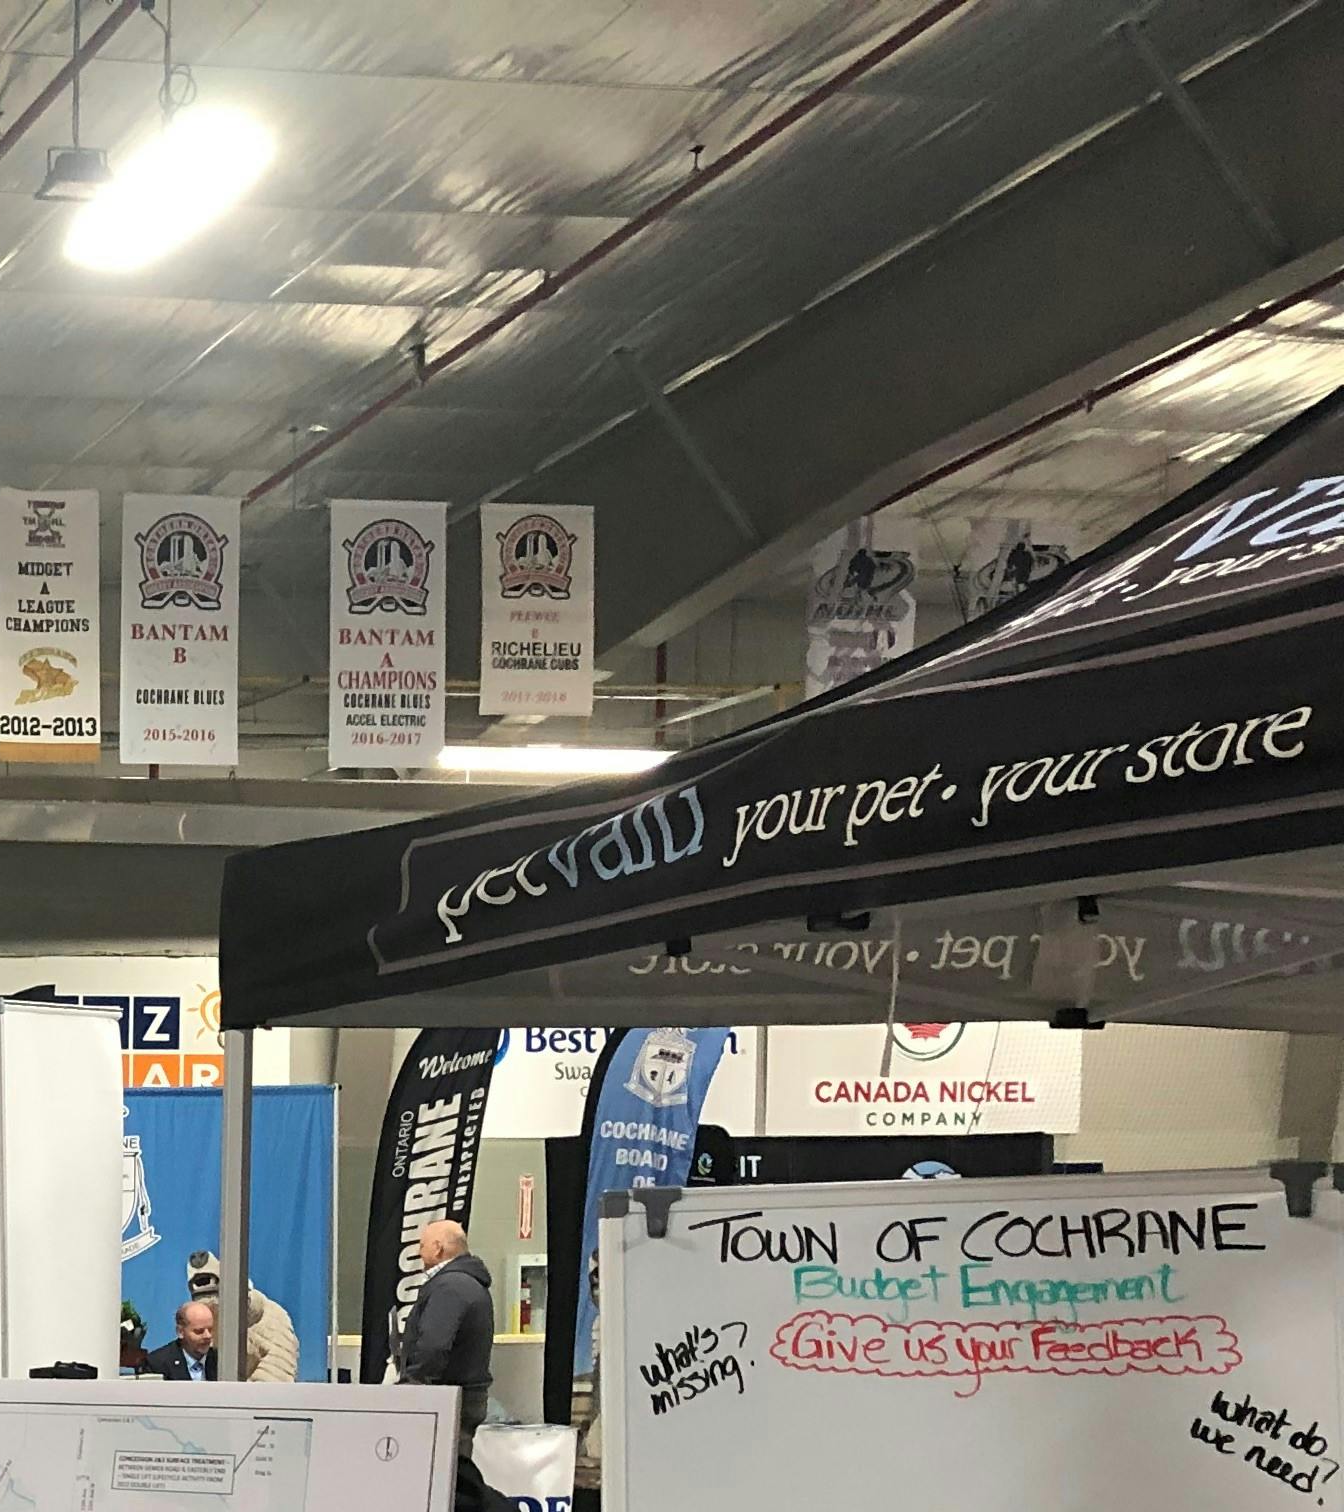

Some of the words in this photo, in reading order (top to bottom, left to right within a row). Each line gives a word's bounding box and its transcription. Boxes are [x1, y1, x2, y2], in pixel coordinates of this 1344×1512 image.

[18, 600, 75, 614] LEAGUE
[5, 617, 90, 633] CHAMPIONS
[131, 623, 229, 641] BANTAM
[338, 628, 435, 647] BANTAM
[491, 641, 582, 657] RICHELIEU
[337, 670, 437, 691] CHAMPIONS
[136, 689, 189, 706] COCHRANE
[194, 689, 225, 706] BLUES
[0, 715, 97, 737] 2012-2013
[345, 714, 377, 728] ACCEL
[380, 714, 426, 728] ELECTRIC
[723, 787, 847, 867] your
[846, 764, 941, 847] pet
[971, 744, 1132, 828] your
[1124, 706, 1311, 784] store
[419, 1048, 493, 1079] Welcome
[815, 1081, 930, 1103] CANADA
[940, 1081, 1035, 1103] NICKEL
[866, 1112, 982, 1127] COMPANY
[392, 1110, 414, 1178] ONTARIO
[689, 1209, 838, 1265] TOWN
[876, 1217, 948, 1262] OF
[960, 1202, 1265, 1263] COCHRANE
[793, 1265, 941, 1324] Budget
[961, 1262, 1187, 1326] Engagement
[792, 1322, 891, 1362] Give
[904, 1331, 948, 1364] us
[952, 1331, 1016, 1399] your
[1031, 1325, 1204, 1366] Feedback
[1190, 1416, 1238, 1454] we
[1290, 1420, 1329, 1457] do
